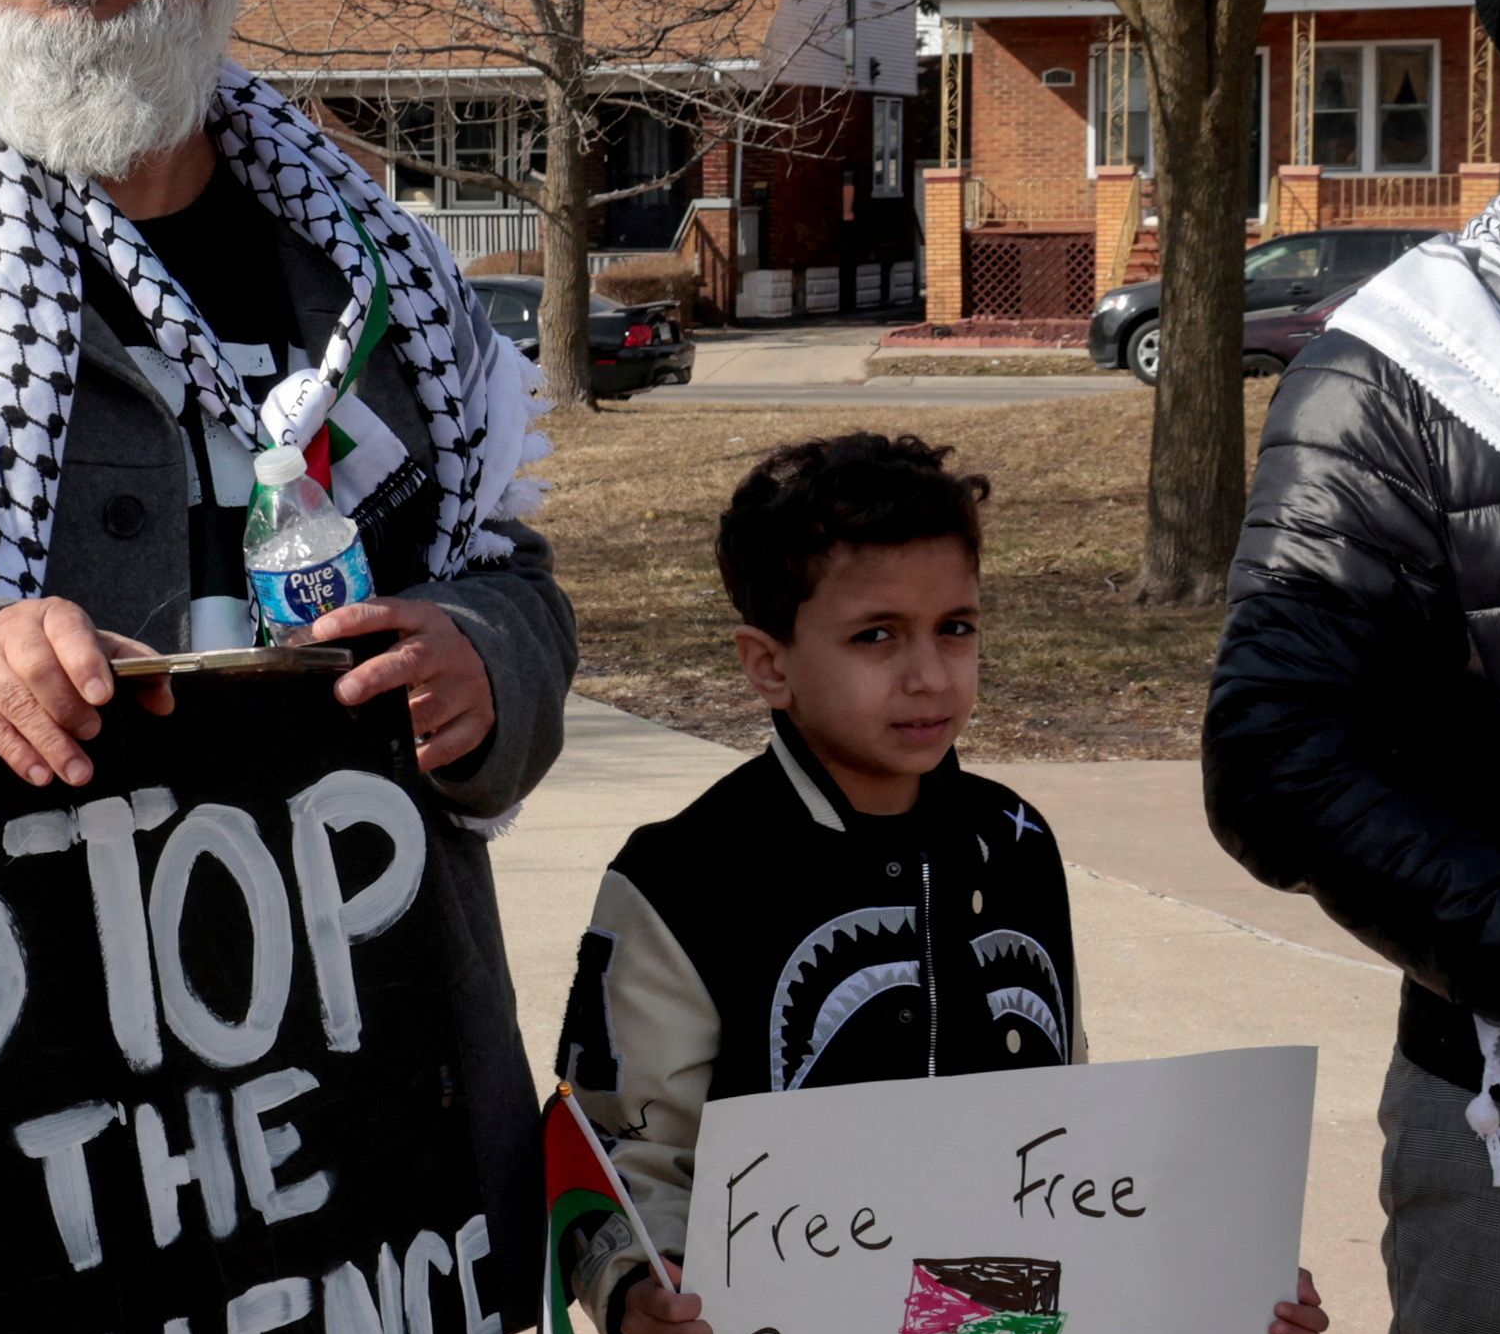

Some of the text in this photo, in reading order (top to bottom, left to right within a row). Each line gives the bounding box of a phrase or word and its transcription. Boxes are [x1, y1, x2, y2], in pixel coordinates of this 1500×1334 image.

[290, 566, 334, 589] Pure
[299, 584, 334, 604] Life
[13, 1066, 335, 1273] THE
[1013, 1126, 1148, 1220] Free
[725, 1152, 894, 1289] Free
